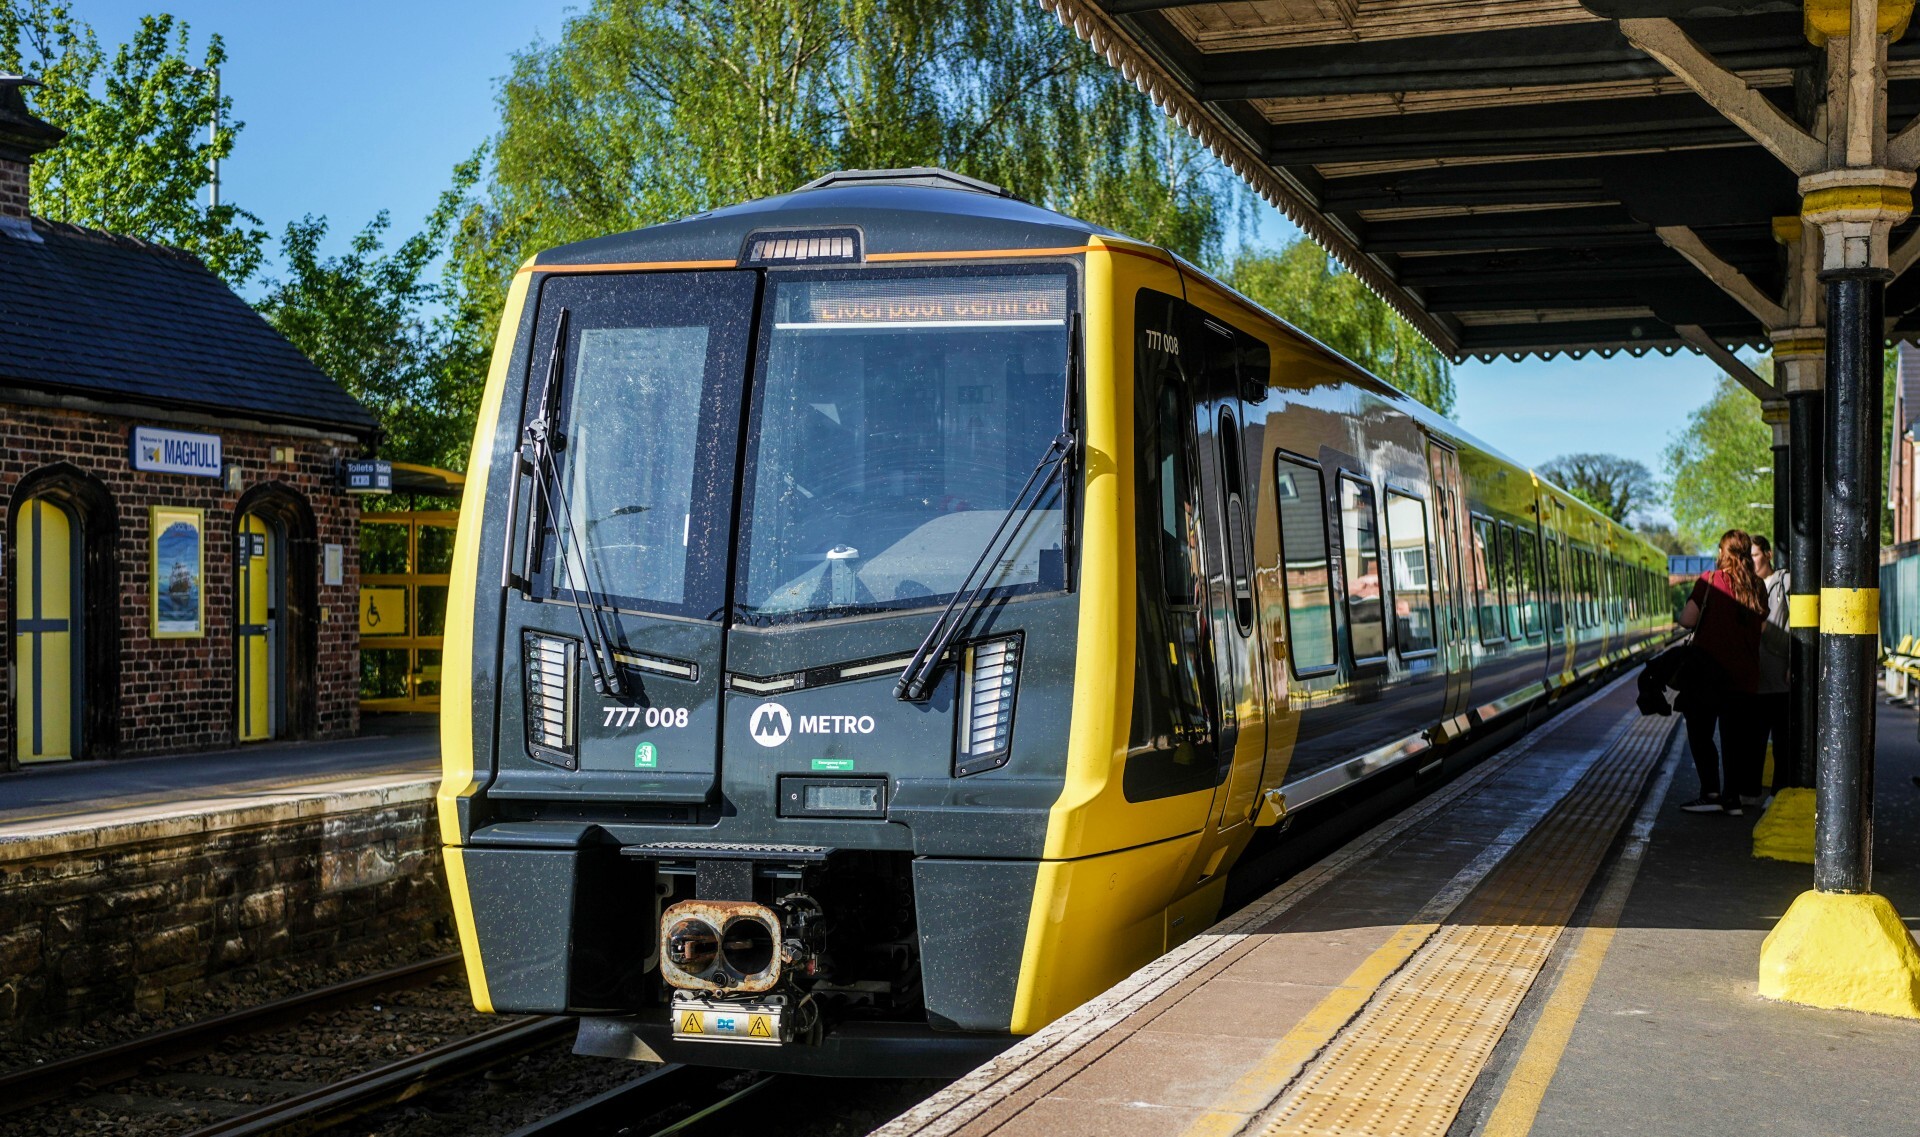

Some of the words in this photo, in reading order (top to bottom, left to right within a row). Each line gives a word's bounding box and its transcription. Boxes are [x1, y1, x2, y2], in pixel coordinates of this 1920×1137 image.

[1146, 329, 1161, 351] 777
[1163, 333, 1179, 355] 008
[164, 439, 218, 468] MAGHULL
[348, 463, 374, 473] Toilets
[603, 707, 639, 727] 777
[646, 707, 689, 728] 008
[799, 715, 875, 734] METRO
